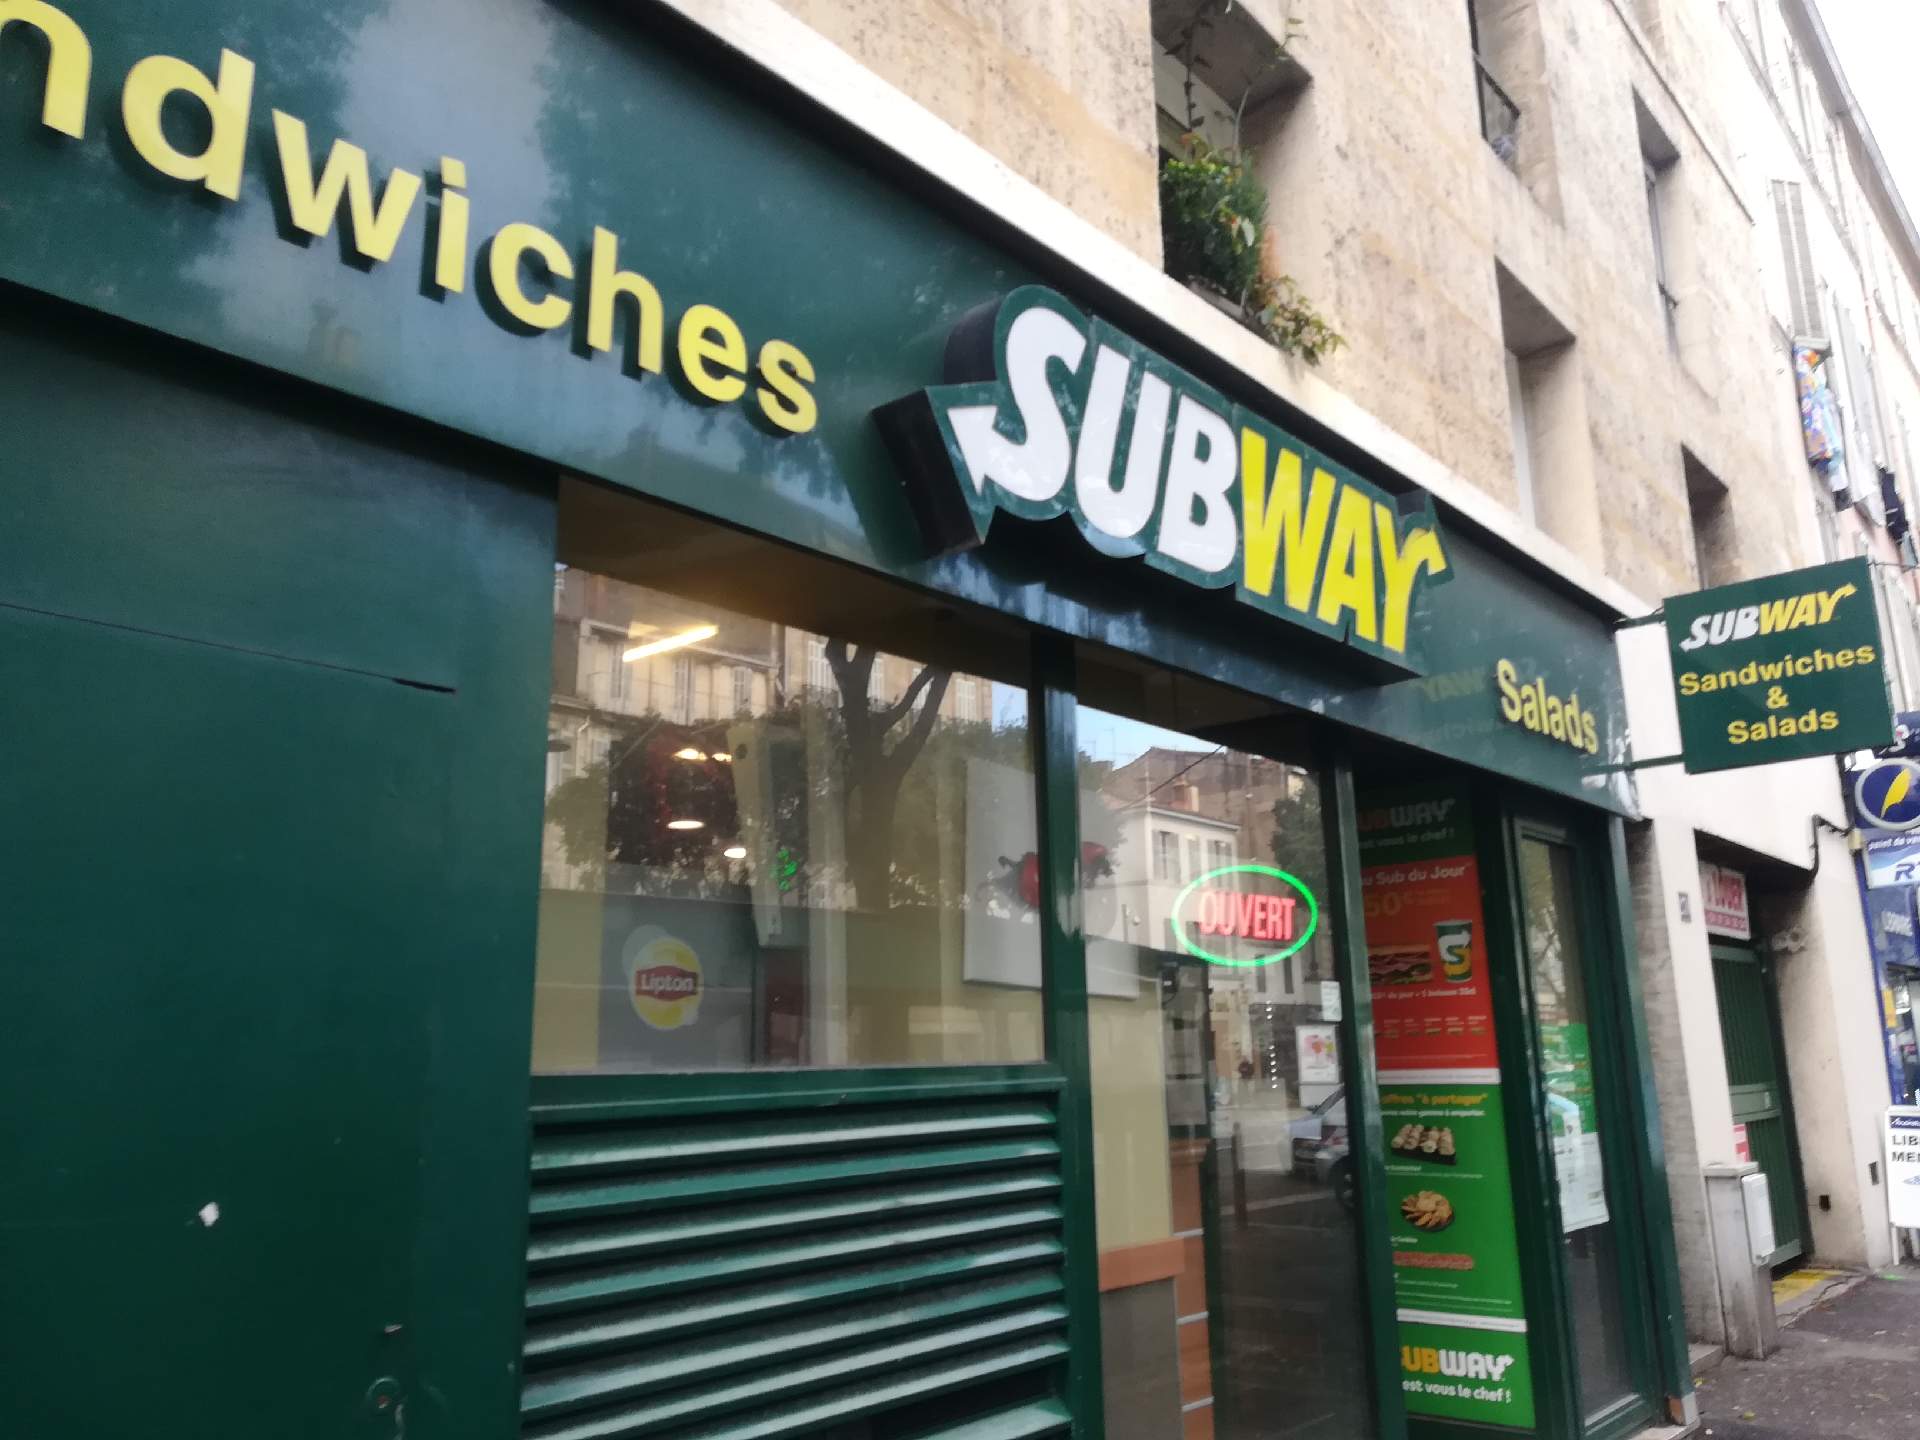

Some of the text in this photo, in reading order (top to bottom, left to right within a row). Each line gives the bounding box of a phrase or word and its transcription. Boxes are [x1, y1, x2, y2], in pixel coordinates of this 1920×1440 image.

[947, 306, 1446, 653] SUBWAY
[1680, 582, 1857, 651] SUBWAY
[1679, 645, 1876, 696] Sandwiches
[1497, 658, 1598, 755] Salads
[1766, 685, 1790, 709] &
[1727, 708, 1840, 744] Salads
[1376, 870, 1405, 886] Sub
[1408, 867, 1427, 882] du
[1430, 864, 1465, 880] Jour
[1200, 890, 1296, 941] OUVERT
[641, 973, 693, 994] Lipton
[1892, 1151, 1920, 1162] ME
[1402, 1380, 1424, 1393] est
[1425, 1383, 1456, 1396] vous
[1458, 1384, 1472, 1398] le
[1473, 1386, 1504, 1402] chef
